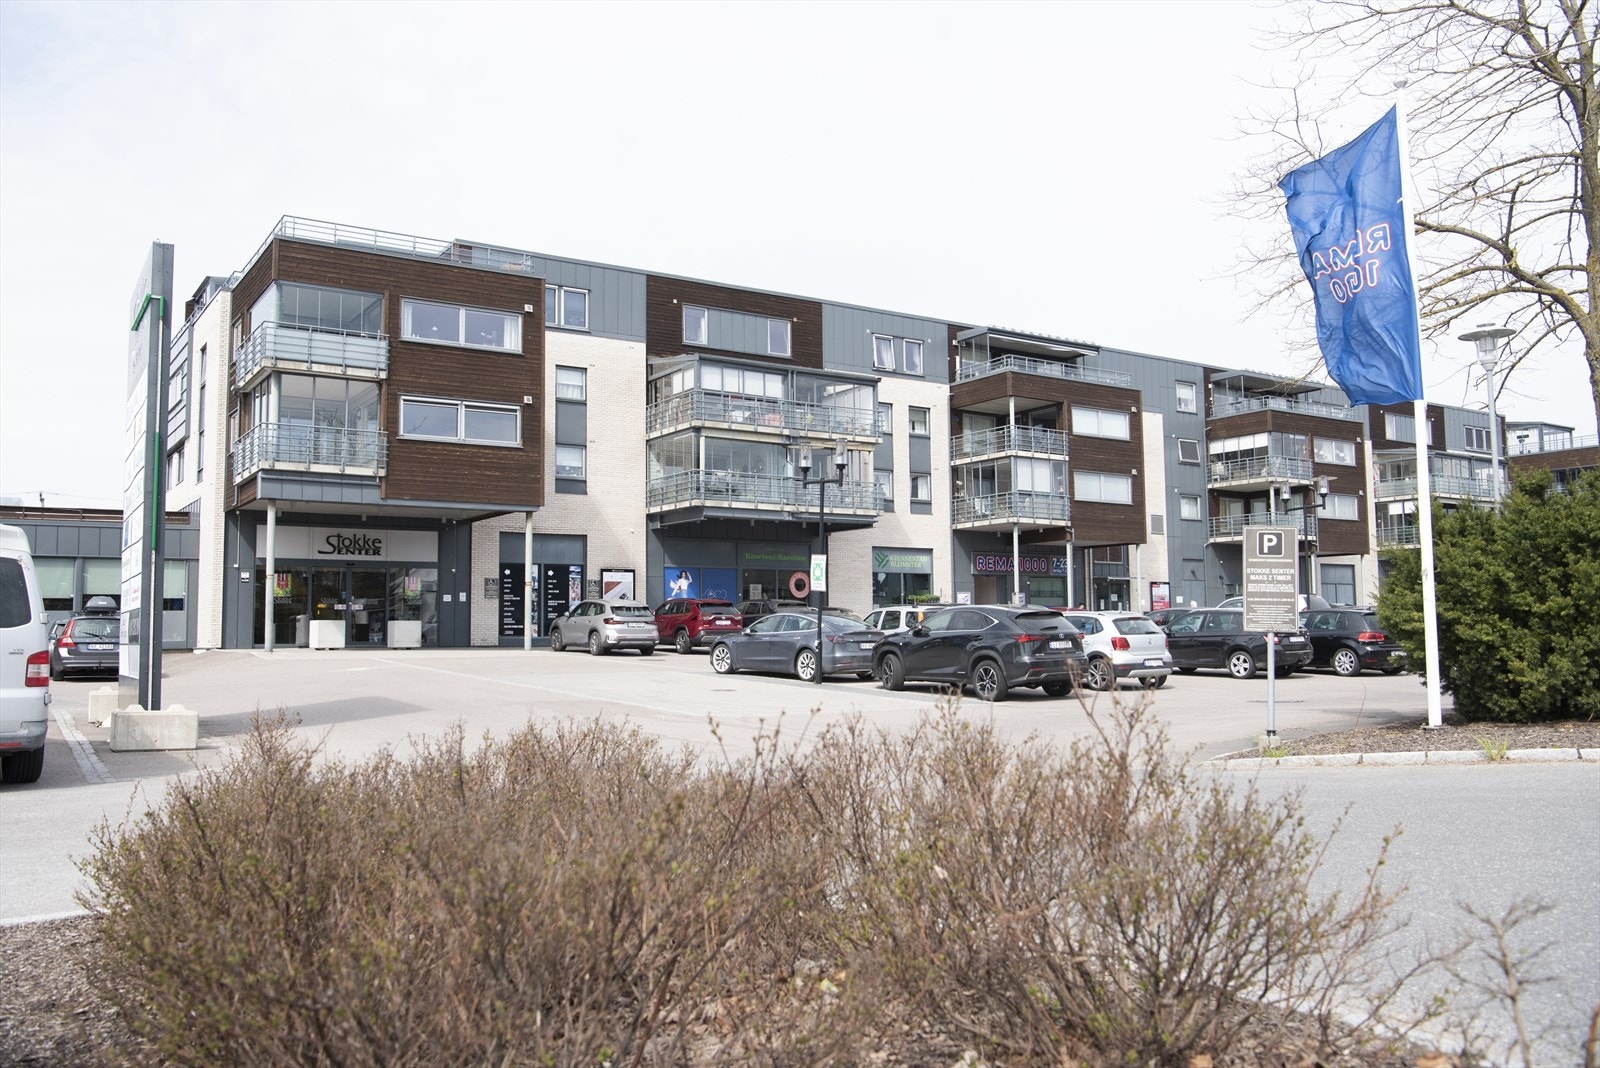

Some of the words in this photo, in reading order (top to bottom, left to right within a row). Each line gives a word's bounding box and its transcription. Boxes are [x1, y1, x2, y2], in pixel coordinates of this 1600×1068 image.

[318, 533, 382, 555] Stokke
[1263, 534, 1278, 553] P
[976, 555, 1015, 571] REMA
[1018, 558, 1047, 572] 1000
